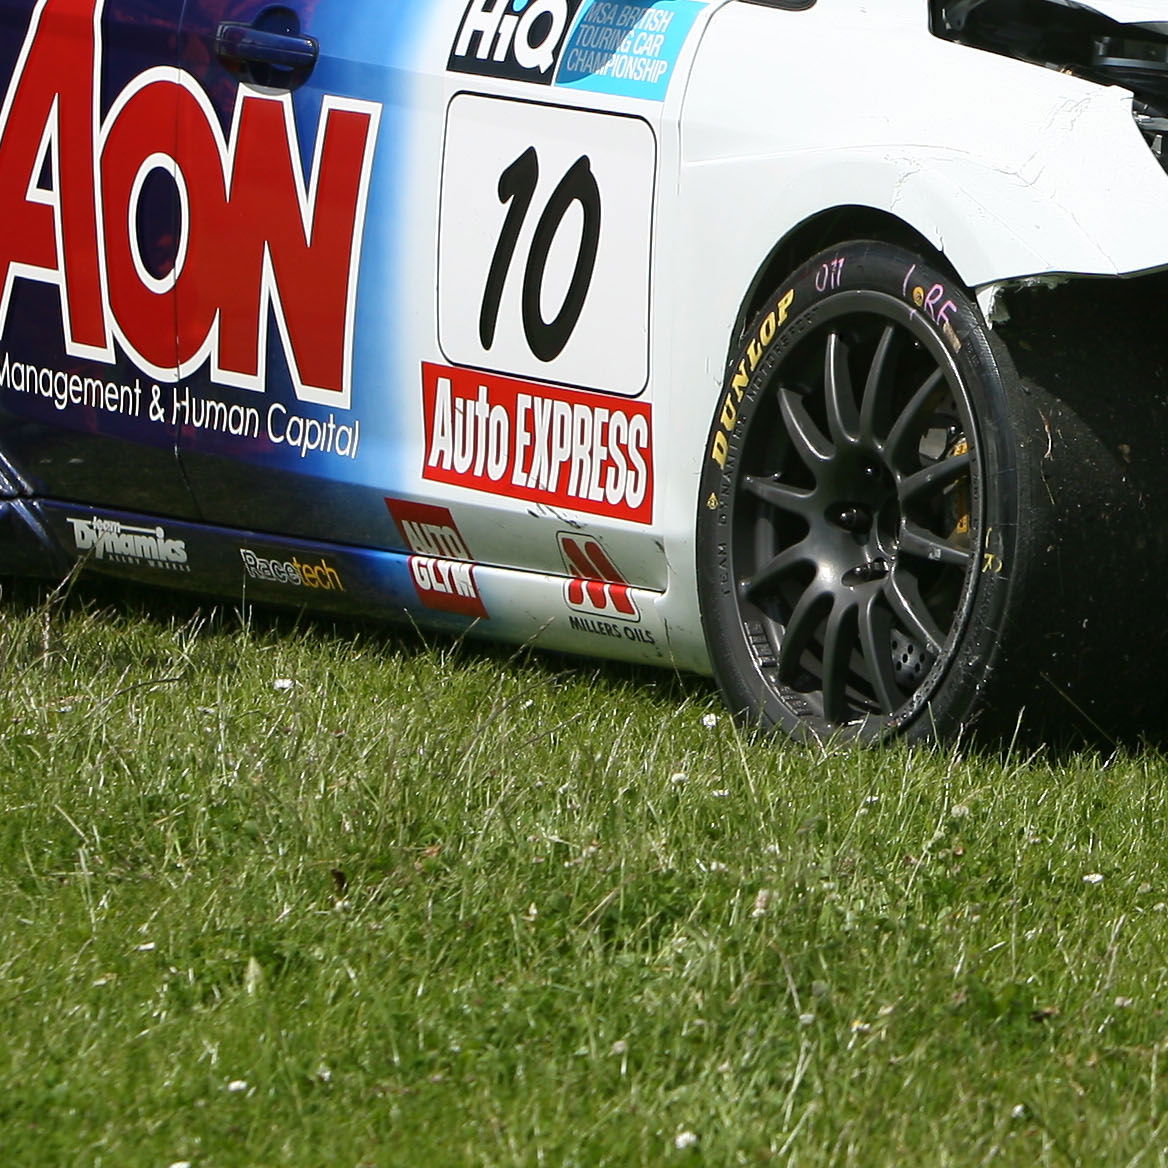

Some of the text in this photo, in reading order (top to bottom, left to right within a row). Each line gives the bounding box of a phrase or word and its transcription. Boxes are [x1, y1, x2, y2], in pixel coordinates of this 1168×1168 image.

[583, 2, 675, 33] MSA BRITISH
[575, 24, 665, 58] TOURING CAR
[566, 48, 668, 84] CHAMPIONSHIP
[479, 146, 601, 363] 10
[711, 288, 795, 470] DUNLOP
[149, 384, 165, 423] &
[173, 387, 259, 439] Human
[267, 403, 360, 459] Capital
[510, 392, 649, 510] EXPRESS
[401, 519, 470, 560] AUTO
[411, 556, 478, 599] GLYM
[568, 616, 656, 645] MILLERS OILS
